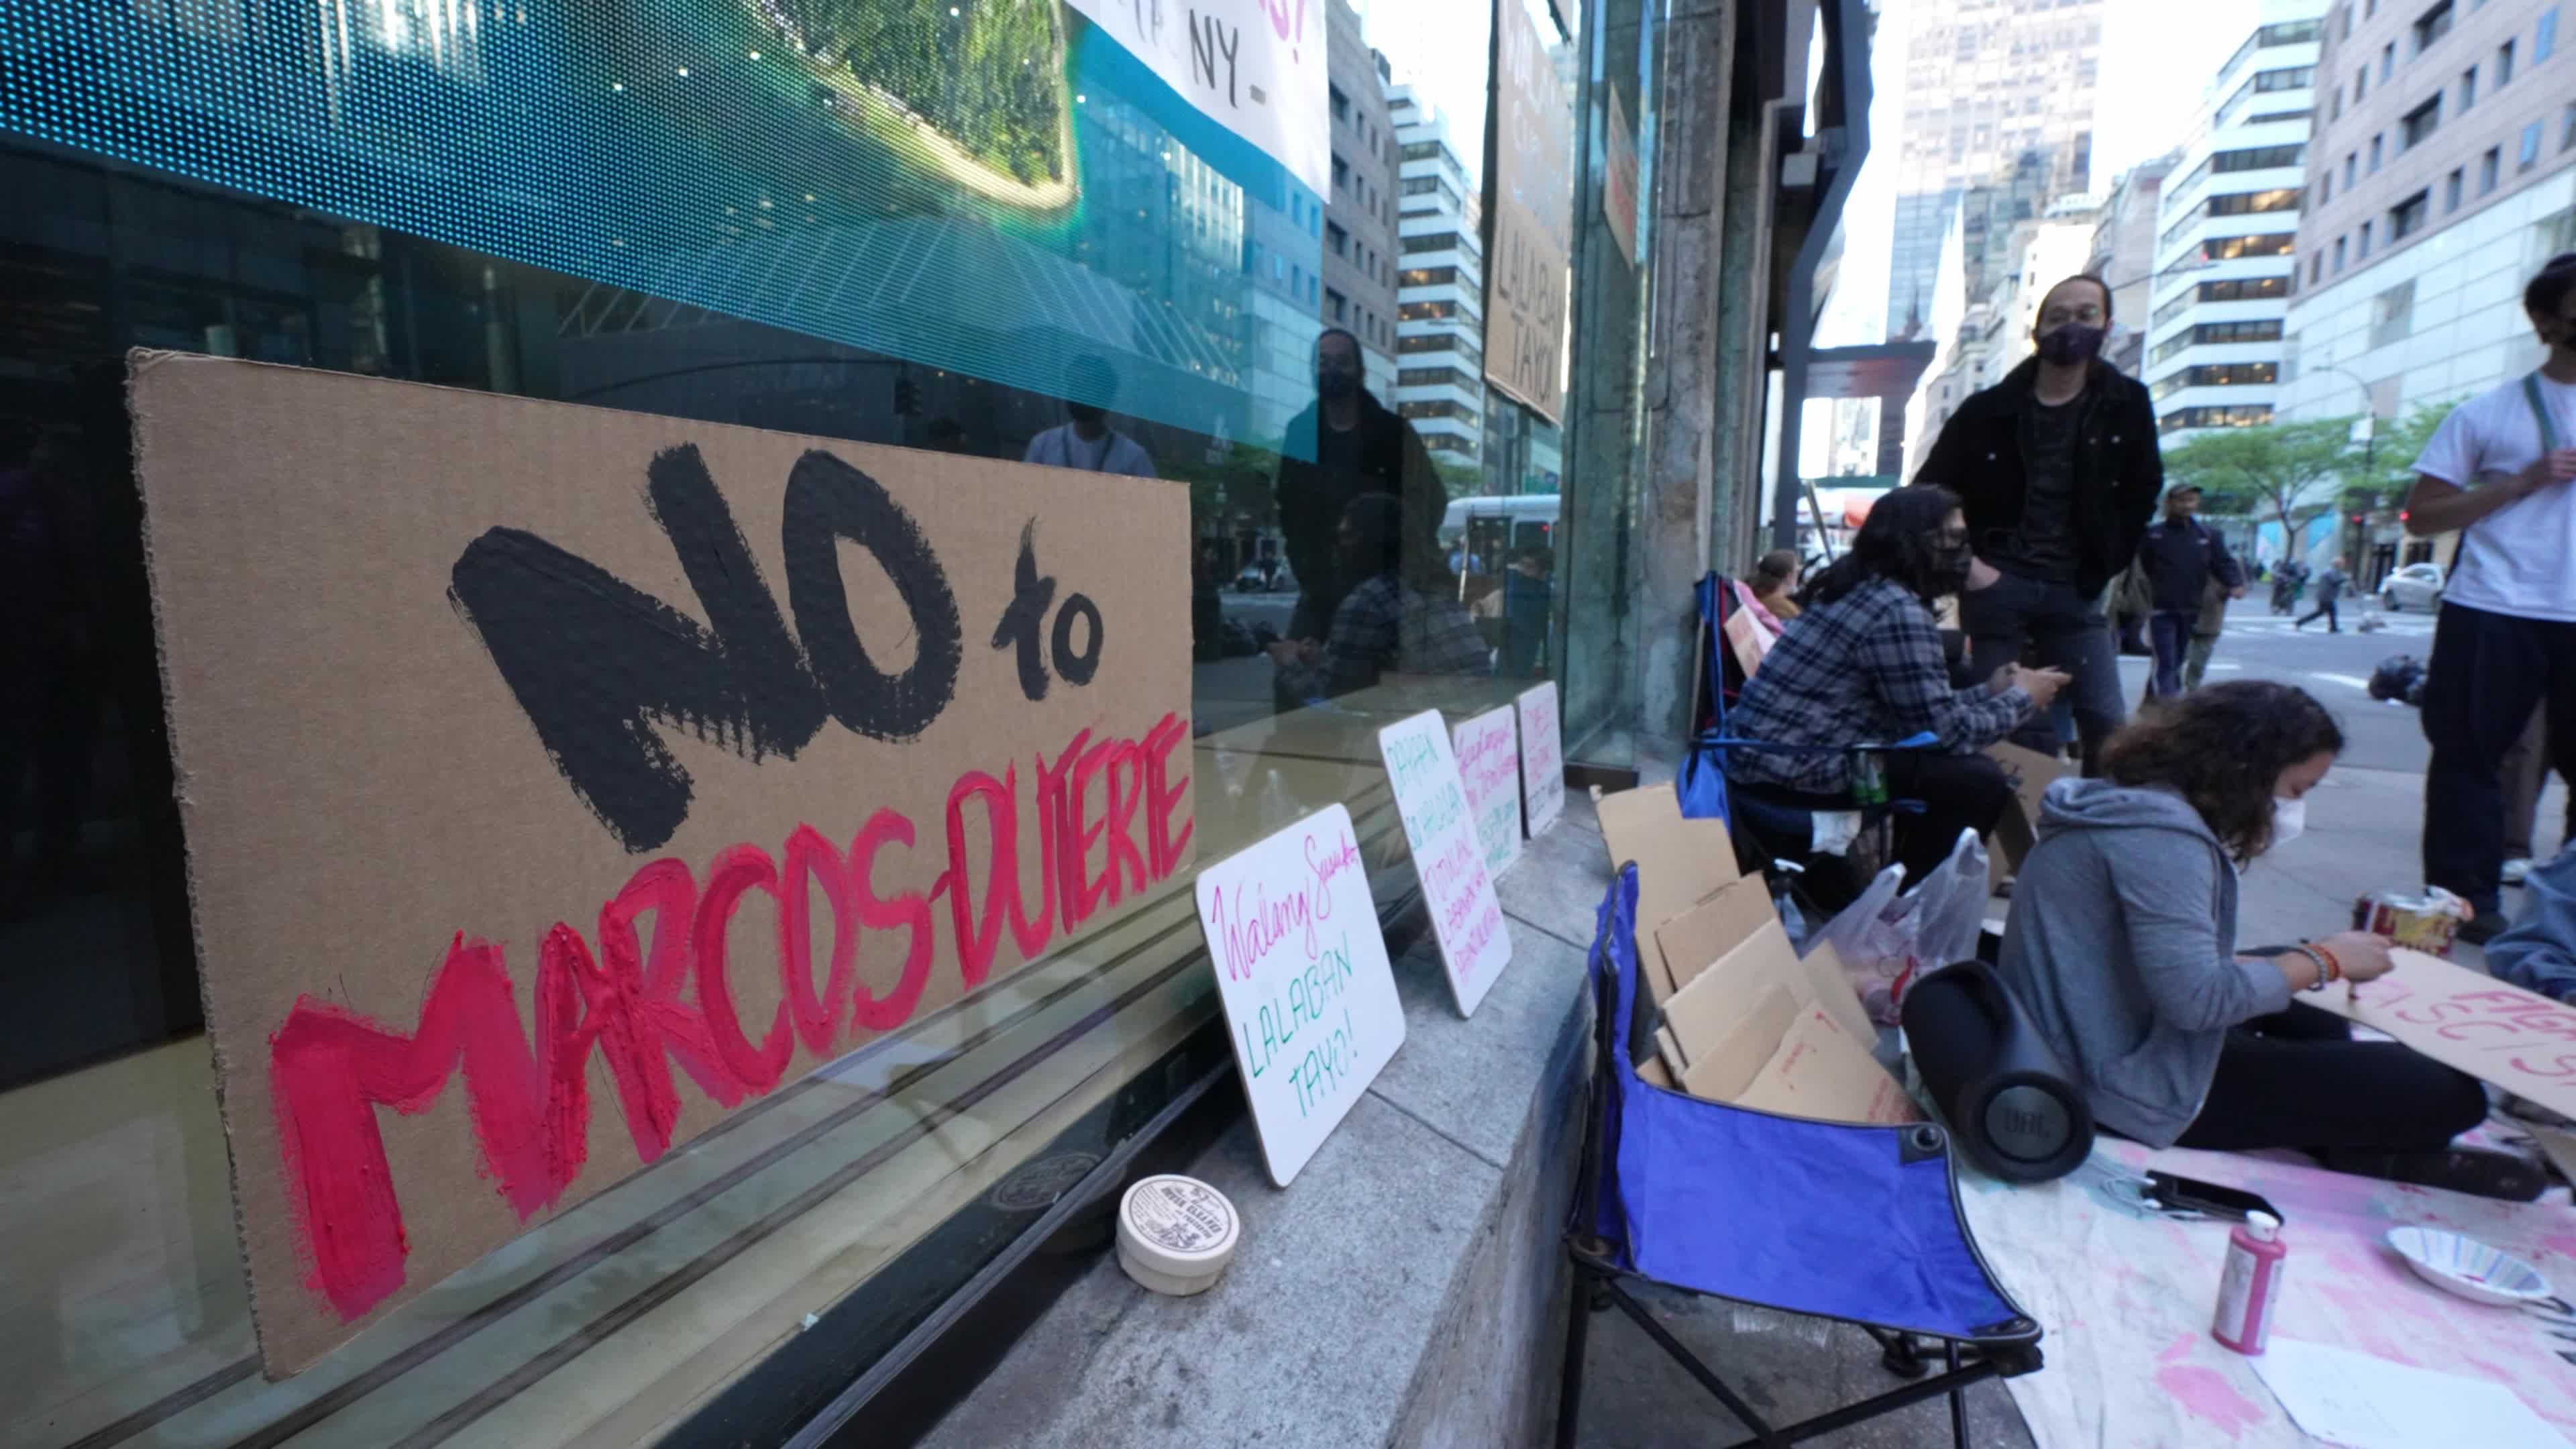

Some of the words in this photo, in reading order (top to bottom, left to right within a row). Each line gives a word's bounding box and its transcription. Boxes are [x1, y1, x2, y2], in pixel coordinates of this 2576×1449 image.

[447, 441, 962, 853] NO
[990, 516, 1104, 700] to
[1243, 930, 1353, 1079] LALABAN
[1289, 1009, 1358, 1117] TAYO!
